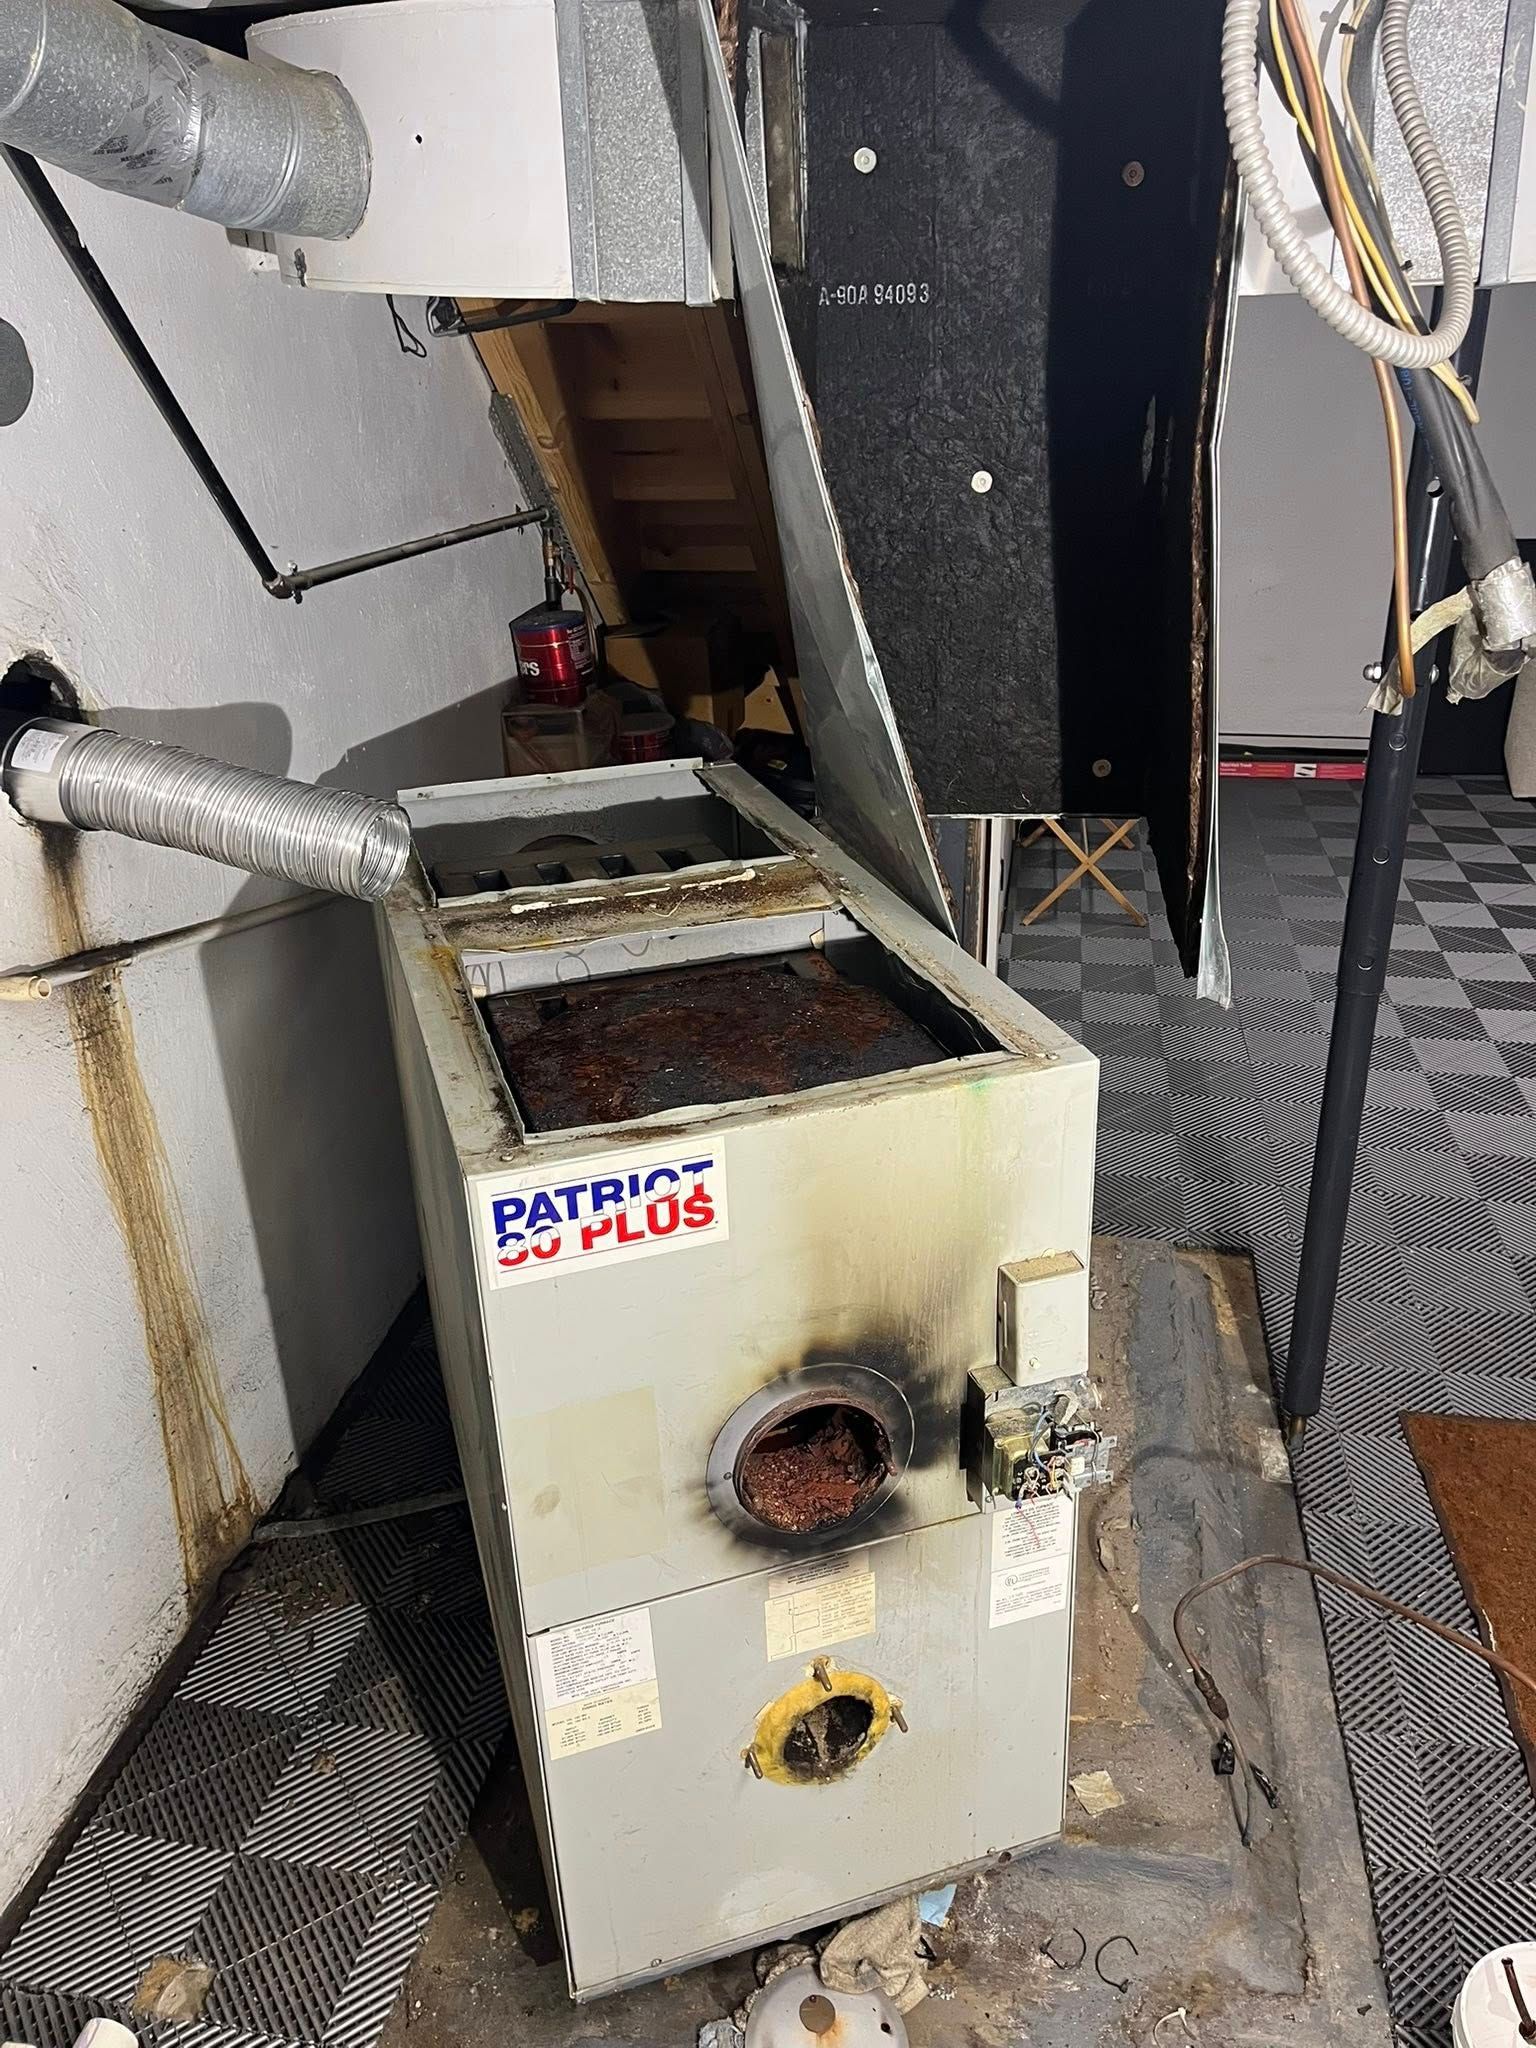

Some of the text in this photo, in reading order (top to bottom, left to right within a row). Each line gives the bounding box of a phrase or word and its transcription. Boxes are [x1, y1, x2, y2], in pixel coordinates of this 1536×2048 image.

[819, 283, 929, 305] A-90A 94093
[492, 1160, 713, 1235] PATRIOT
[497, 1194, 715, 1266] 80 PLUS
